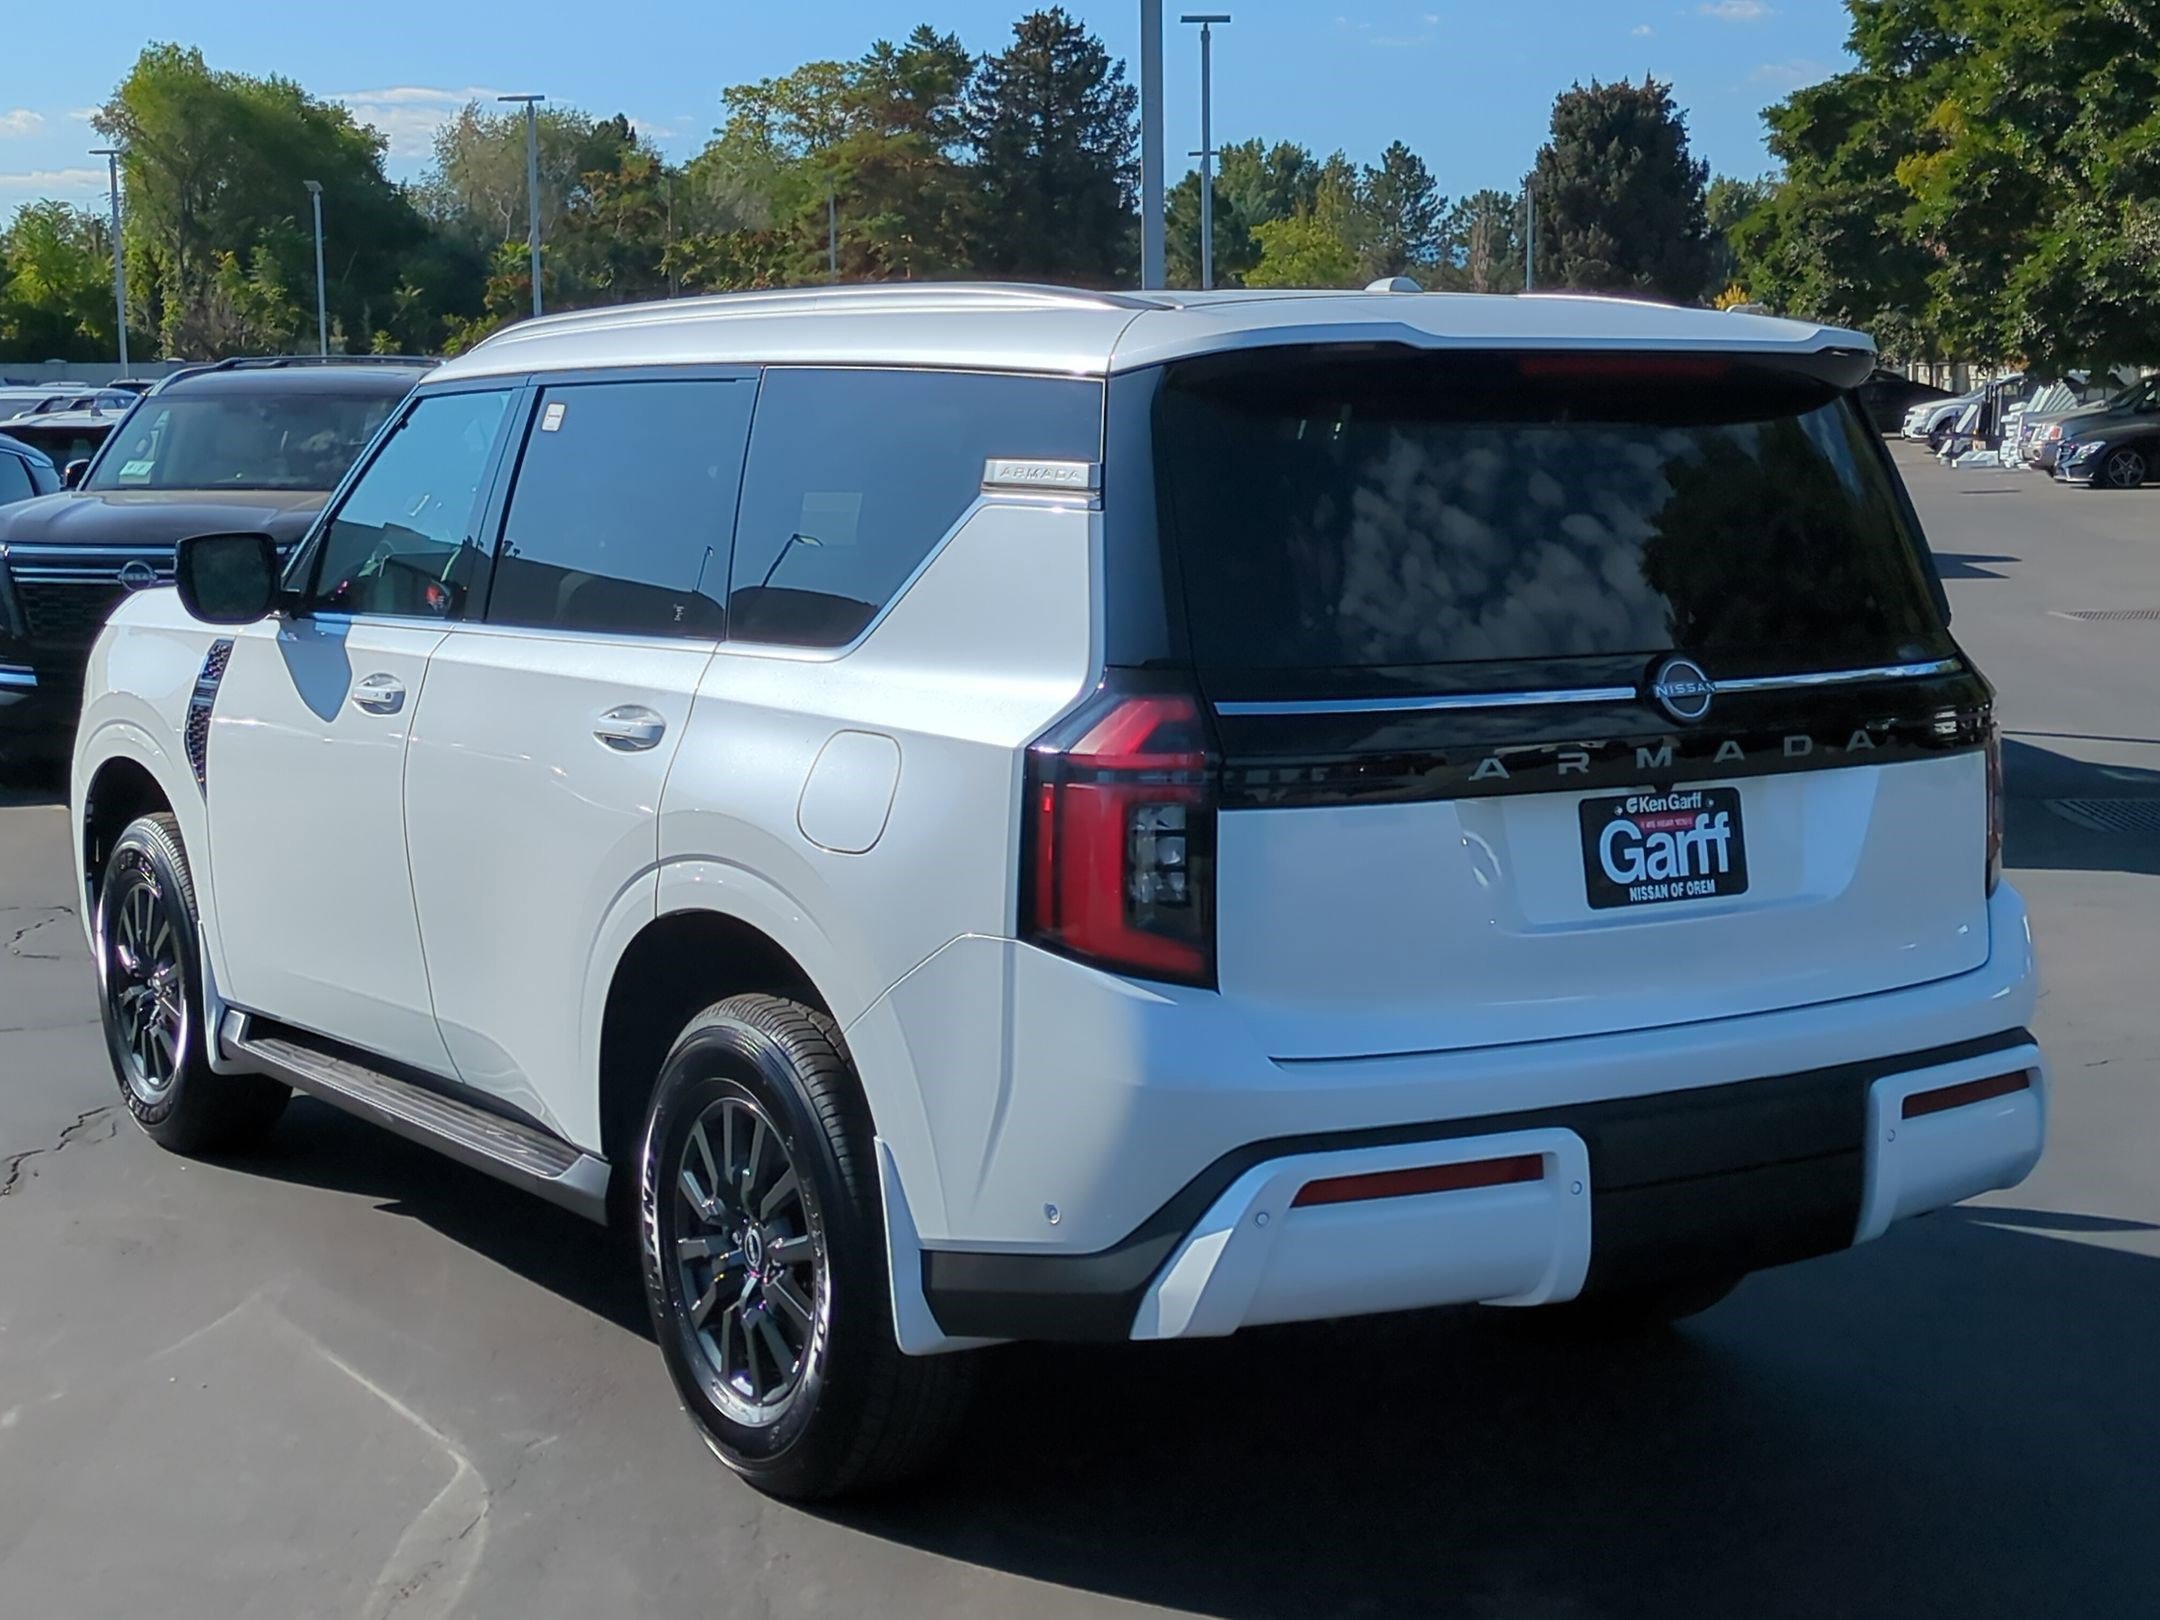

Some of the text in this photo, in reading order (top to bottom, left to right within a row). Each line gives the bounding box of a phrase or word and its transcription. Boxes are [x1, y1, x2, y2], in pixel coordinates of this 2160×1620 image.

[1000, 466, 1081, 481] ARMADA
[1655, 682, 1716, 698] NISSAN
[1467, 729, 1876, 781] ARMADA
[1639, 792, 1702, 813] Ken Garff
[1600, 811, 1731, 884] Garff
[1629, 879, 1716, 902] NISSAN OF OREM
